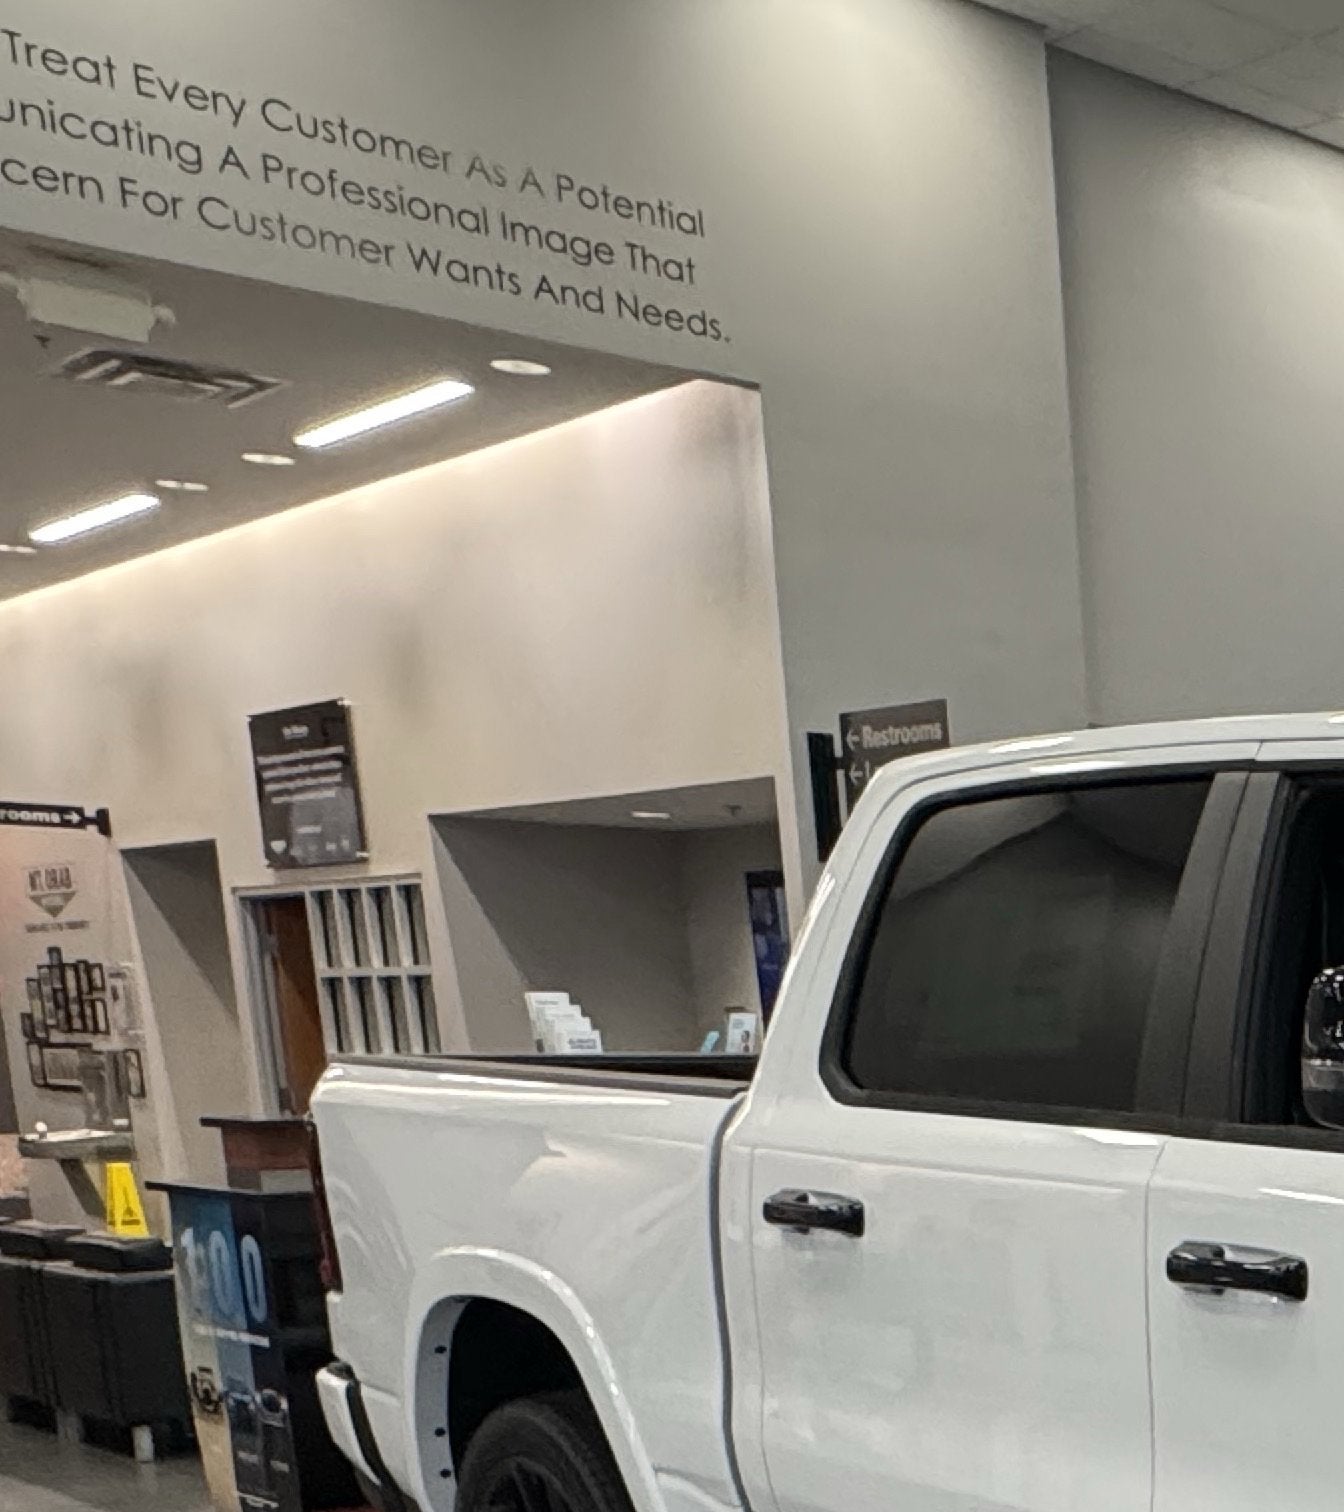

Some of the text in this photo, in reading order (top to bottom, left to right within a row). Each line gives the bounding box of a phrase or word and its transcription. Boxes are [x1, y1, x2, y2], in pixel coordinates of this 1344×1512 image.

[0, 28, 706, 238] Treat Every Customer As A Potential
[0, 159, 732, 344] cern For Customer Wants And Needs.
[219, 145, 251, 179] A
[261, 153, 490, 237] Professional
[500, 211, 615, 267] Image
[625, 241, 696, 286] That
[862, 722, 942, 748] Restrooms
